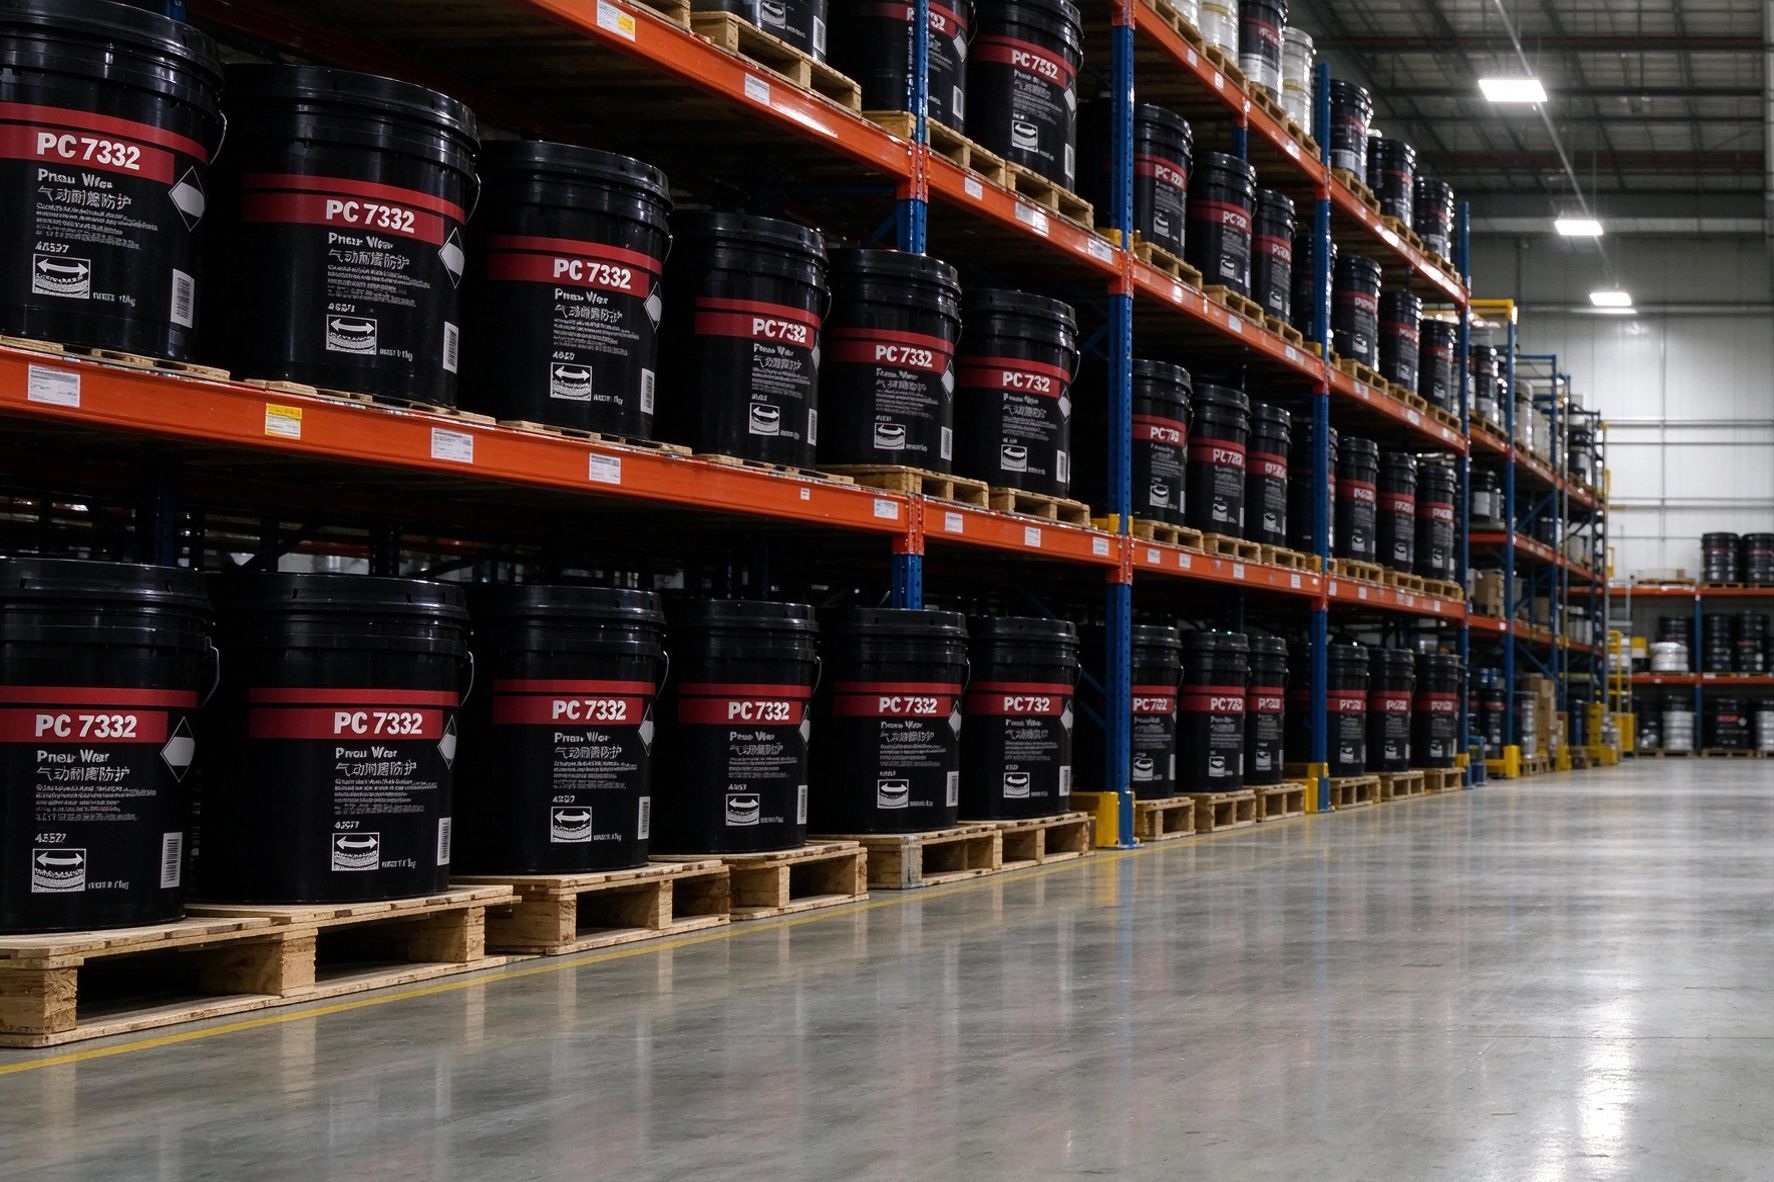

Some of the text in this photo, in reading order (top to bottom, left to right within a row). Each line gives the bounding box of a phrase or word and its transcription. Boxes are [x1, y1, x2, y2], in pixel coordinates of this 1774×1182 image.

[1012, 50, 1030, 67] PC
[37, 132, 140, 170] PC 7332
[326, 200, 414, 233] PC 7332
[554, 259, 631, 289] PC 7332
[753, 318, 776, 337] PC
[876, 345, 897, 361] PC
[1003, 372, 1023, 387] PC
[553, 700, 626, 720] PC 7332
[729, 702, 789, 720] PC 7332
[879, 697, 937, 713] PC 7332
[1004, 697, 1023, 711] PC
[36, 714, 137, 738] PC 7332
[334, 712, 422, 734] PC 7332
